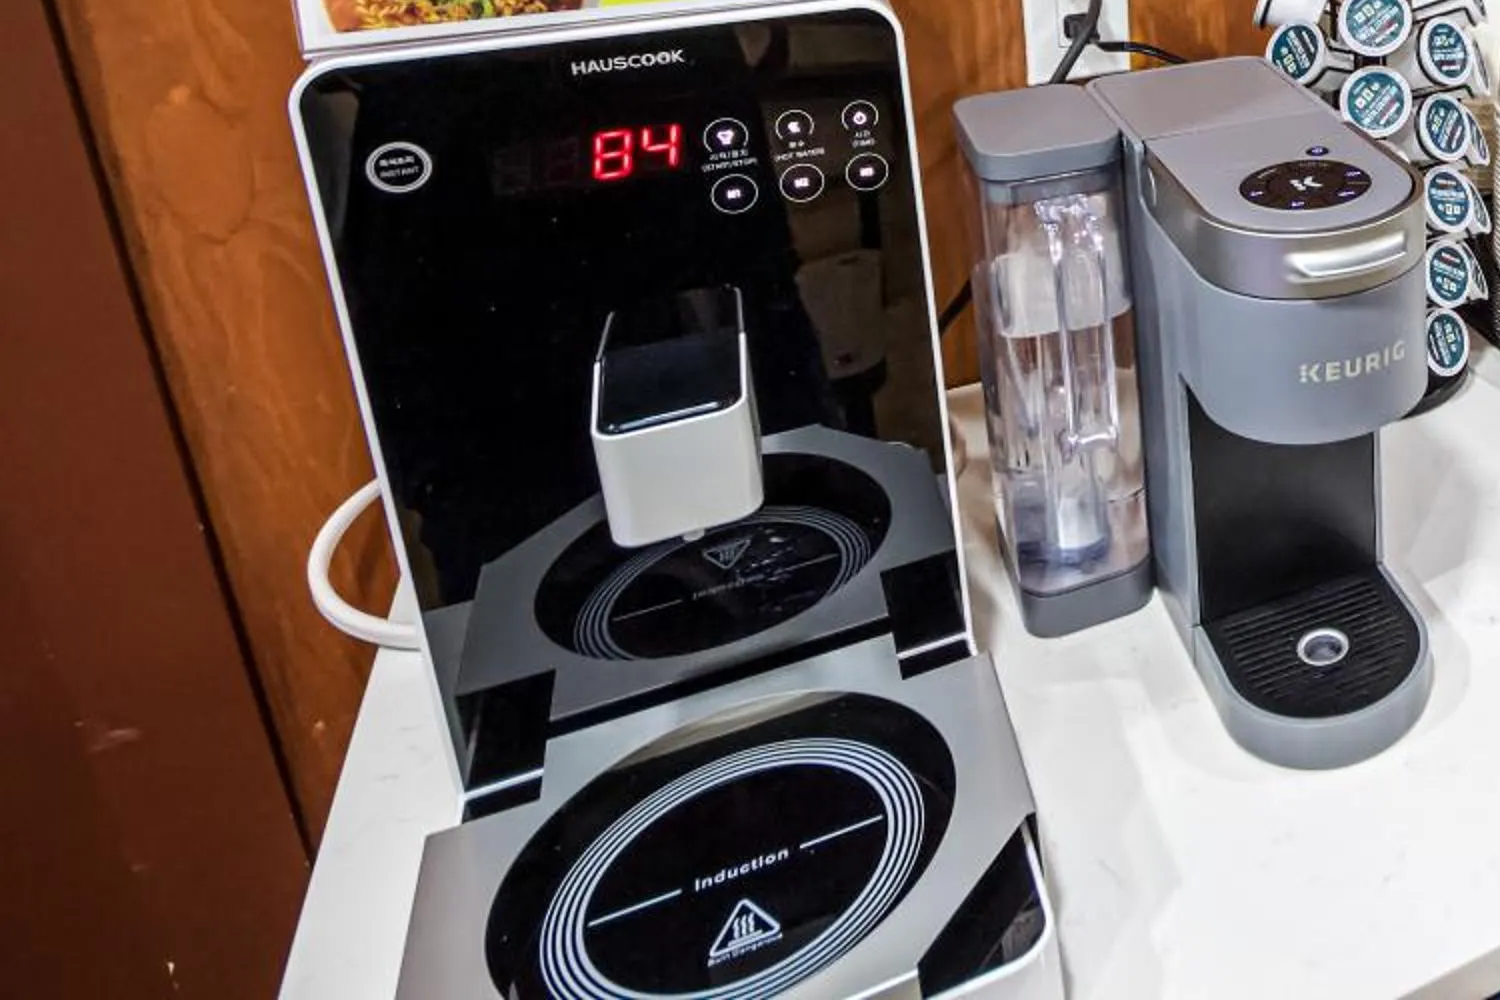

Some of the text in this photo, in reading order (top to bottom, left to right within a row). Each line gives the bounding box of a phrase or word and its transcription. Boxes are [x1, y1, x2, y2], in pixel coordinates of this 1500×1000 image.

[571, 48, 686, 76] HAUSCOOK
[591, 122, 682, 180] 84
[1299, 340, 1407, 384] KEURIG
[695, 848, 789, 893] Induction
